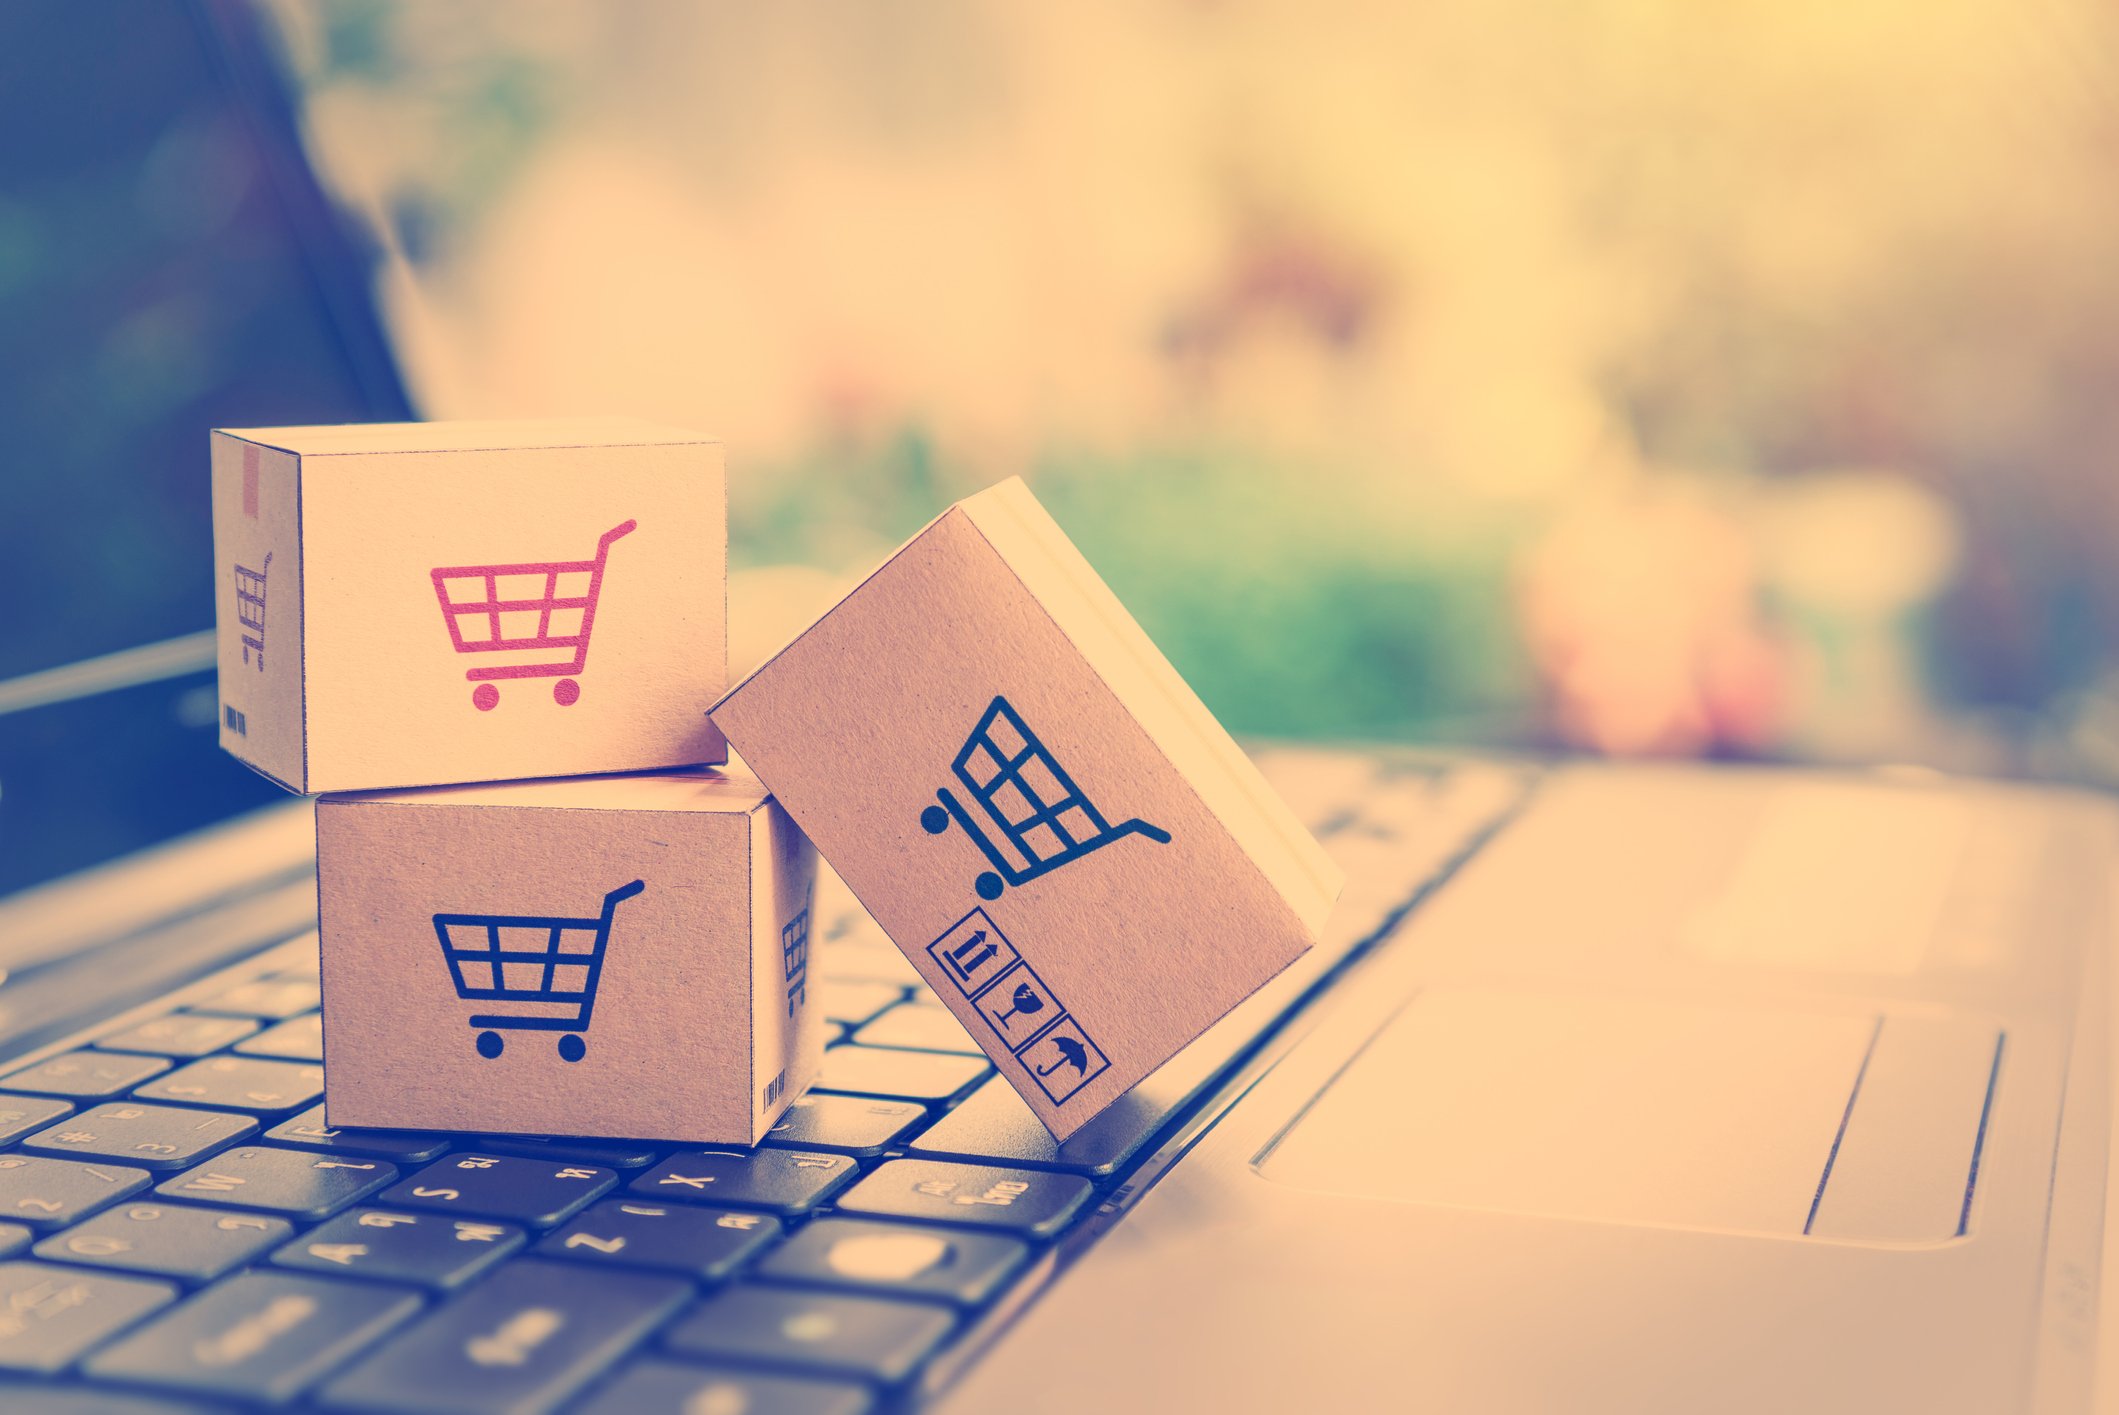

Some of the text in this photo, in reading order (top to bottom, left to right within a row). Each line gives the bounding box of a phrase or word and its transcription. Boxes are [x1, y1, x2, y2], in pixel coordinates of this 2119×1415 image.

[57, 1131, 97, 1144] #
[136, 1143, 177, 1155] 3
[183, 1173, 247, 1191] W
[659, 1174, 715, 1188] X
[413, 1186, 460, 1200] S
[18, 1199, 63, 1212] 2
[68, 1235, 132, 1255] Q
[565, 1233, 626, 1253] Z
[308, 1243, 369, 1265] A
